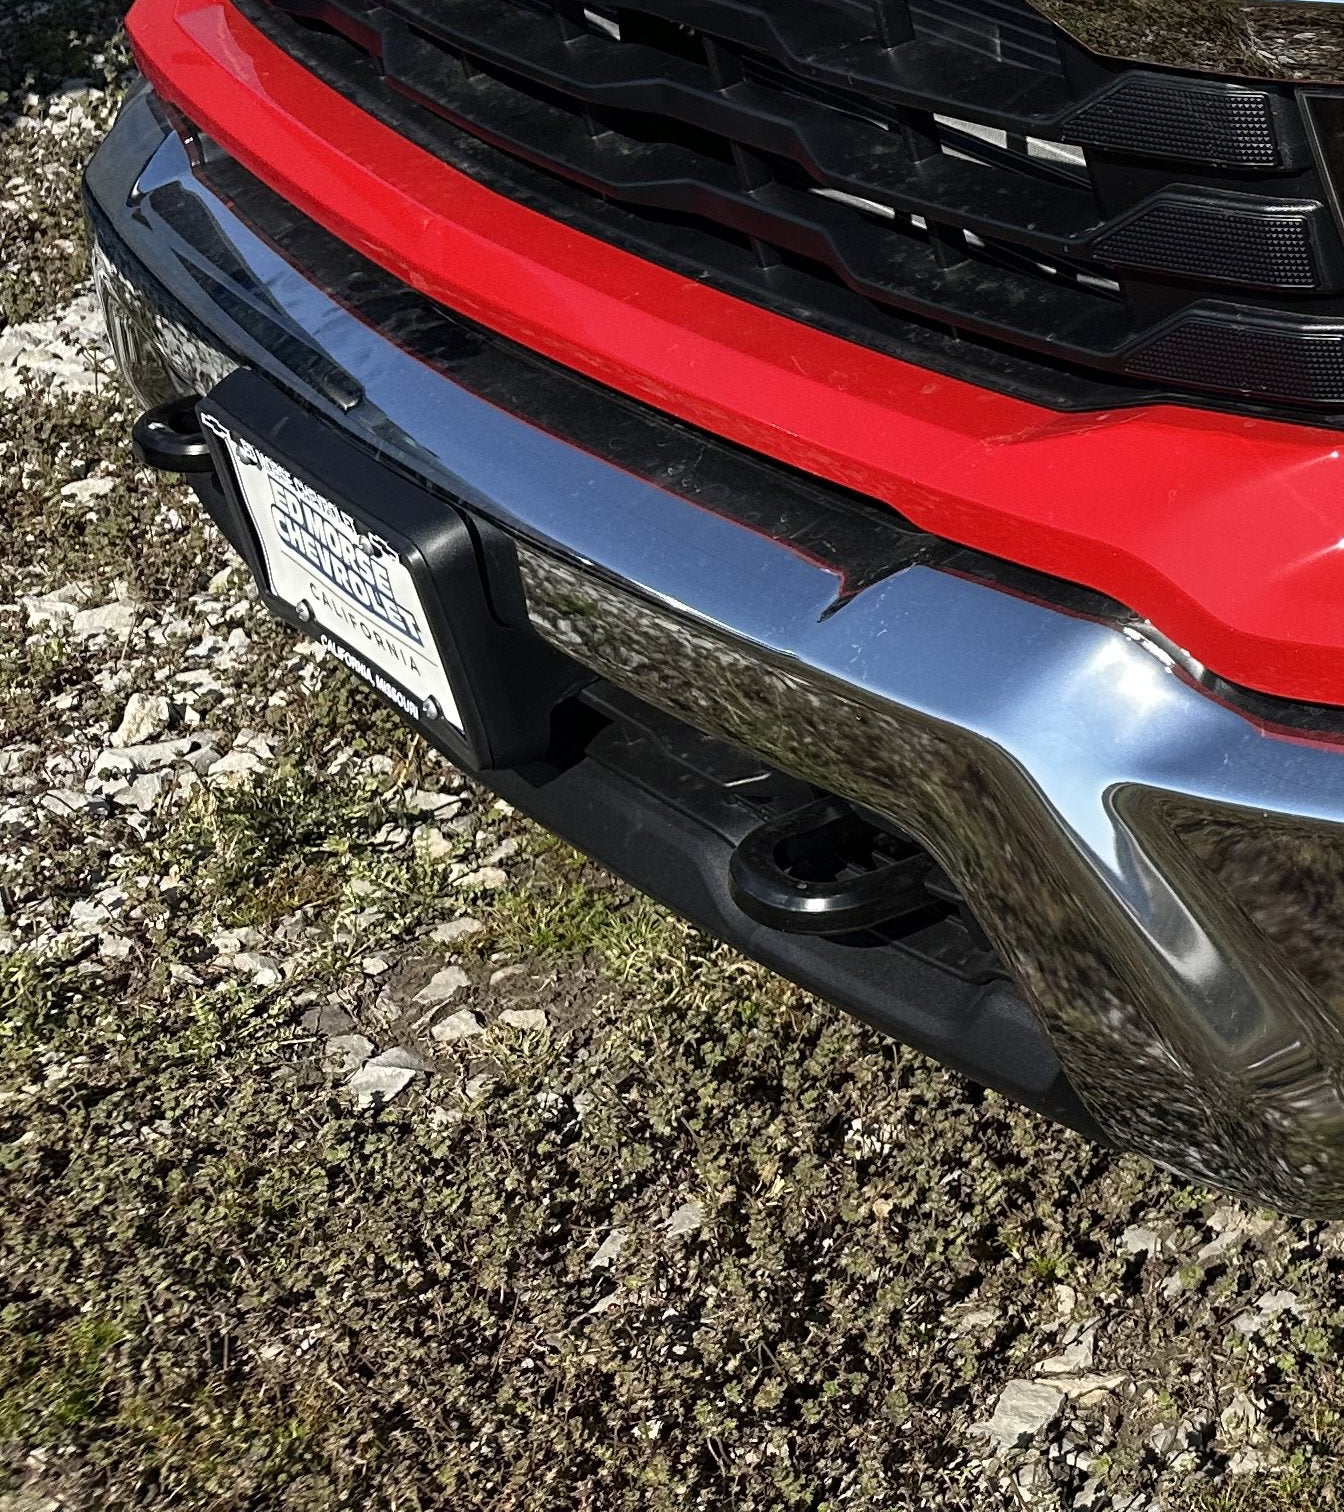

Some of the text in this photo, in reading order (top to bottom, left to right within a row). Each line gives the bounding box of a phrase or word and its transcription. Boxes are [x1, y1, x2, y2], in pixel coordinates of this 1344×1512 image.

[268, 474, 395, 603] ED MORSE
[271, 503, 424, 648] CHEVROLET
[309, 582, 421, 678] CALIFORNIA
[375, 673, 419, 721] MISSOURI
